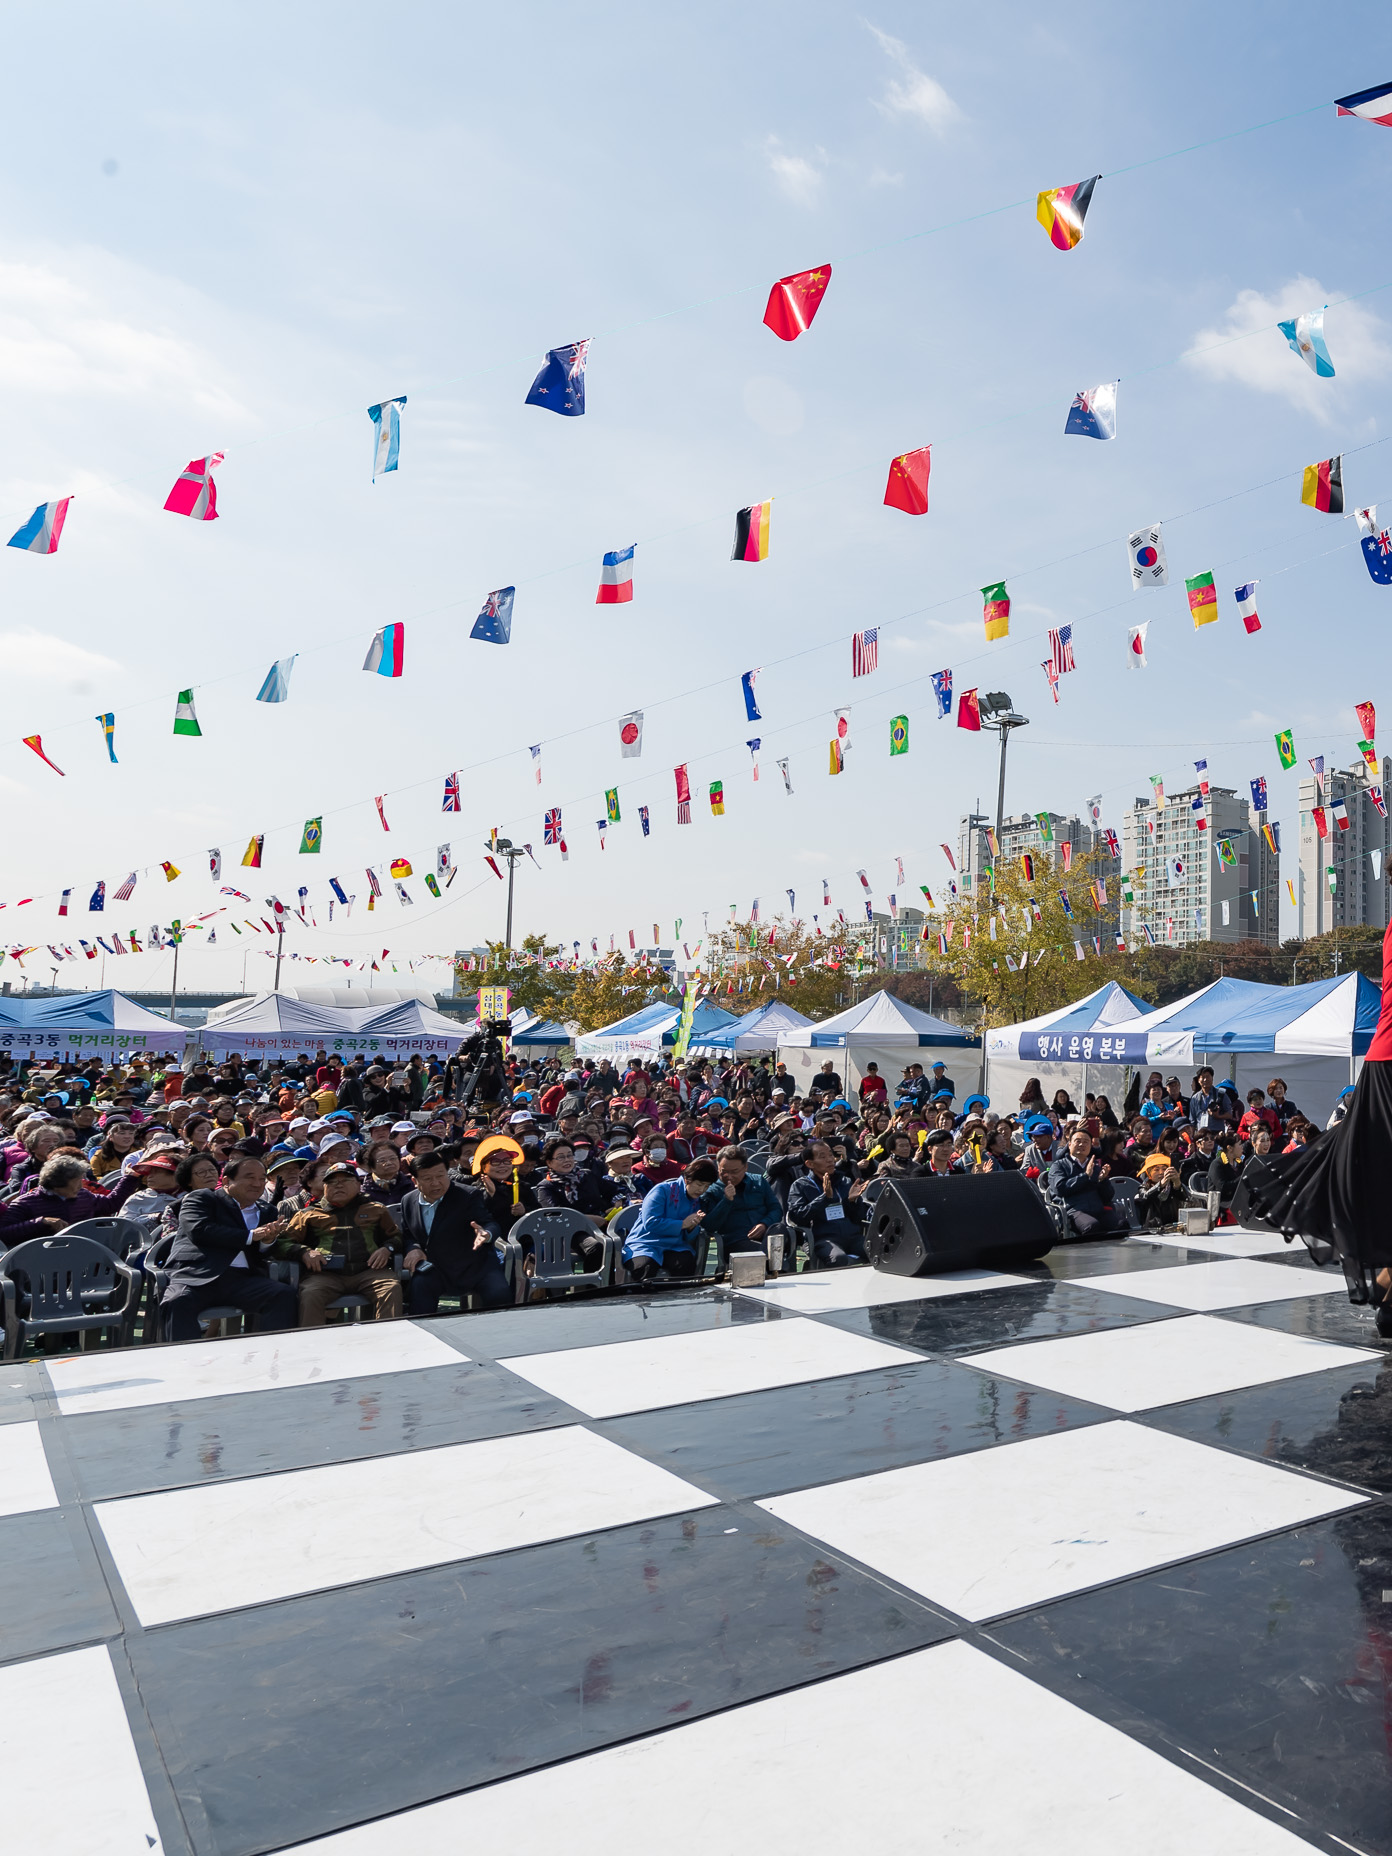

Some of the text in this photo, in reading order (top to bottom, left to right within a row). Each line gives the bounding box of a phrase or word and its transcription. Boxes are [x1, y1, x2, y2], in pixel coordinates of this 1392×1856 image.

[0, 1033, 147, 1047] 중곡3동 먹거리장터
[244, 1038, 449, 1051] 나눔이 있는 마을 중곡2동 먹거리장터
[1037, 1035, 1064, 1058] 행사
[1068, 1036, 1094, 1060] 운영
[1099, 1037, 1127, 1060] 본부
